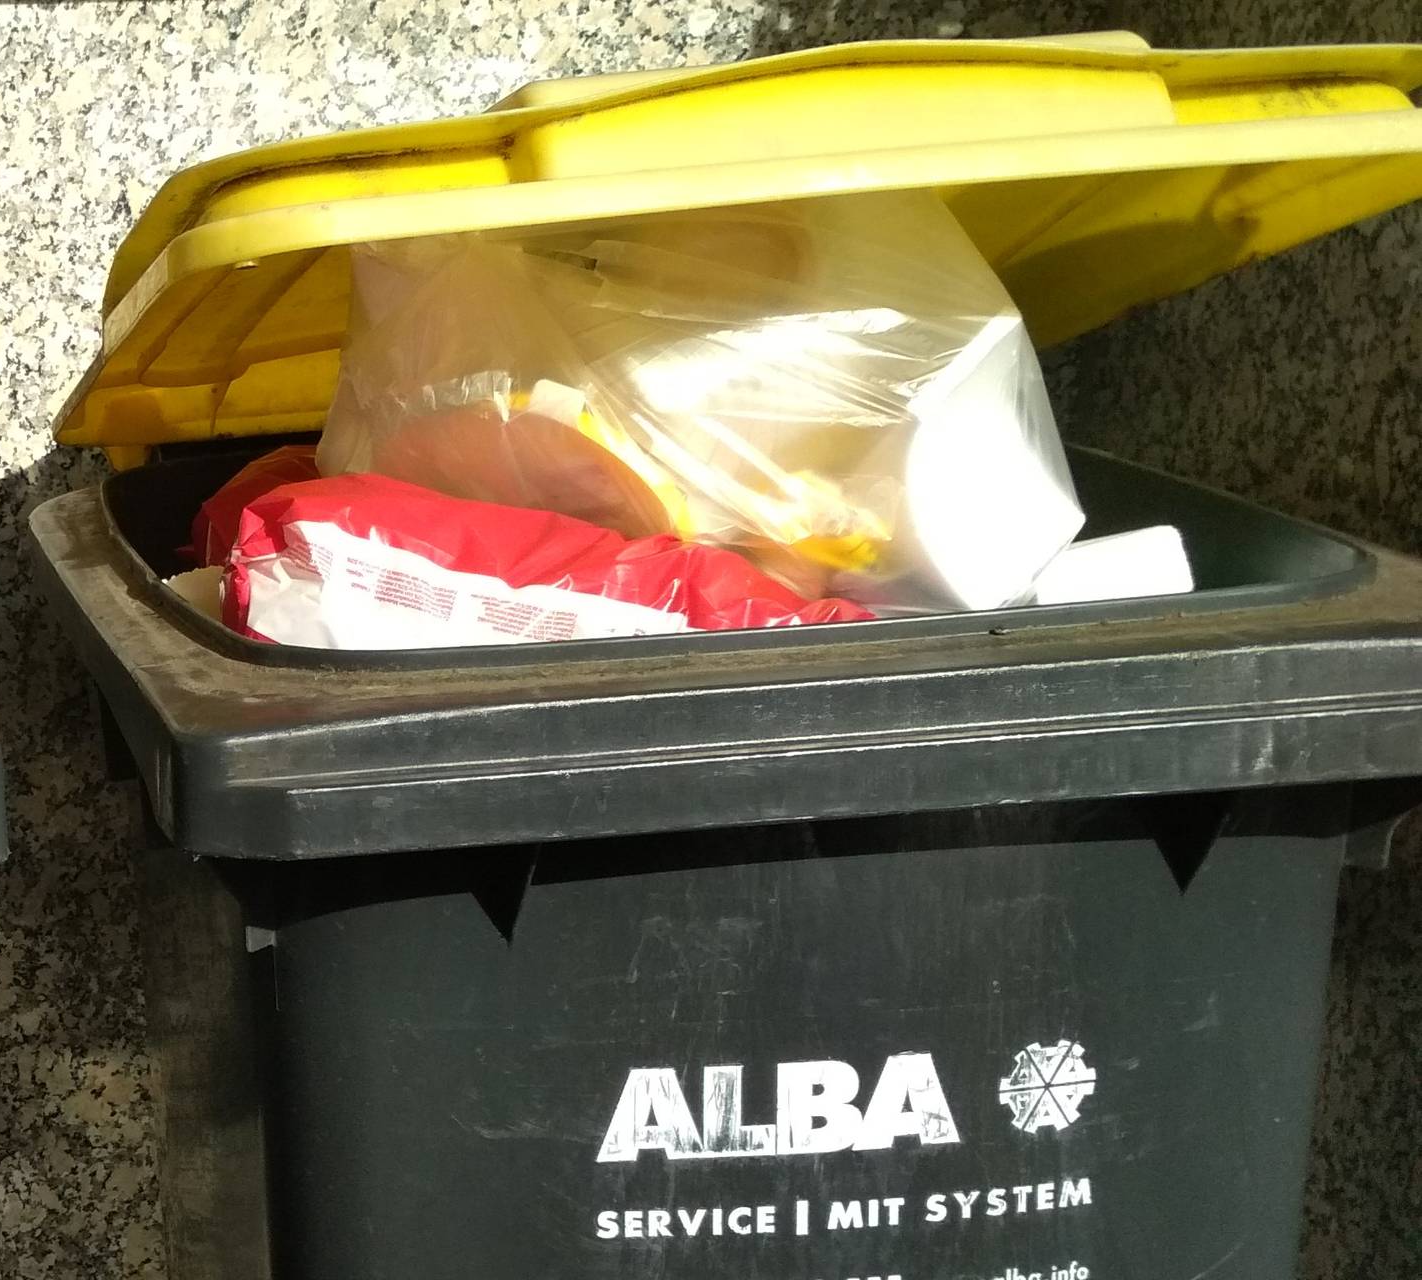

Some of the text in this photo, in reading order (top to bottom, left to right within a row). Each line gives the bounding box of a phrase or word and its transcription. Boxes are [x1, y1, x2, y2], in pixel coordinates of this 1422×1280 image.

[596, 1051, 960, 1163] ALBA
[596, 1206, 776, 1239] SERVICE
[827, 1198, 905, 1230] MIT
[925, 1178, 1092, 1222] SYSTEM
